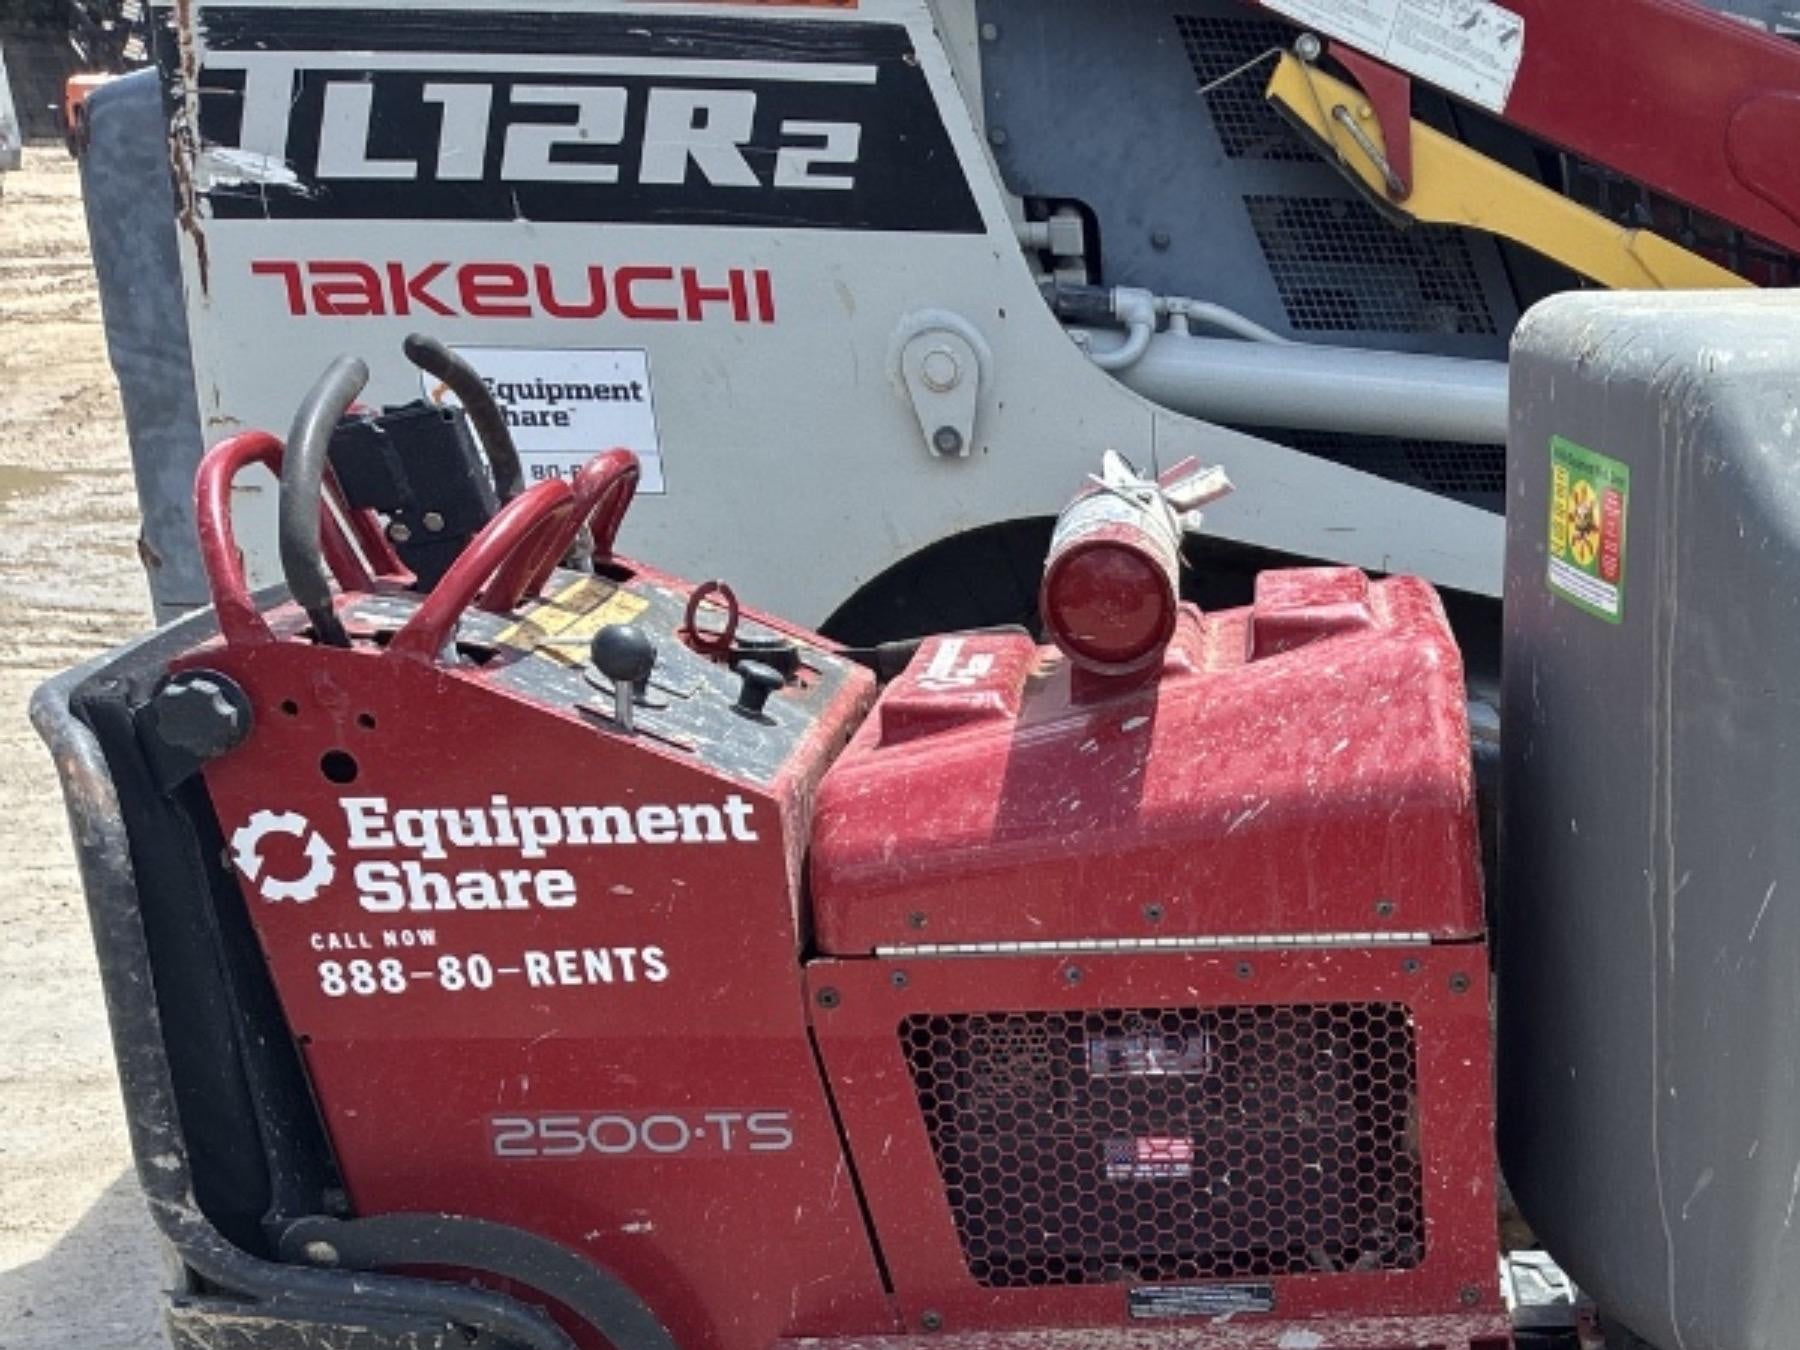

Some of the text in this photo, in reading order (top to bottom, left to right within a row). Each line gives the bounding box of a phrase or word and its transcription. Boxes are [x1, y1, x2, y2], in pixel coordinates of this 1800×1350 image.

[251, 261, 775, 323] TAKEUCHI
[339, 795, 758, 859] Equipment
[353, 860, 578, 912] Share
[311, 929, 437, 949] CALL NOW
[318, 946, 669, 996] 888-80-RENTS
